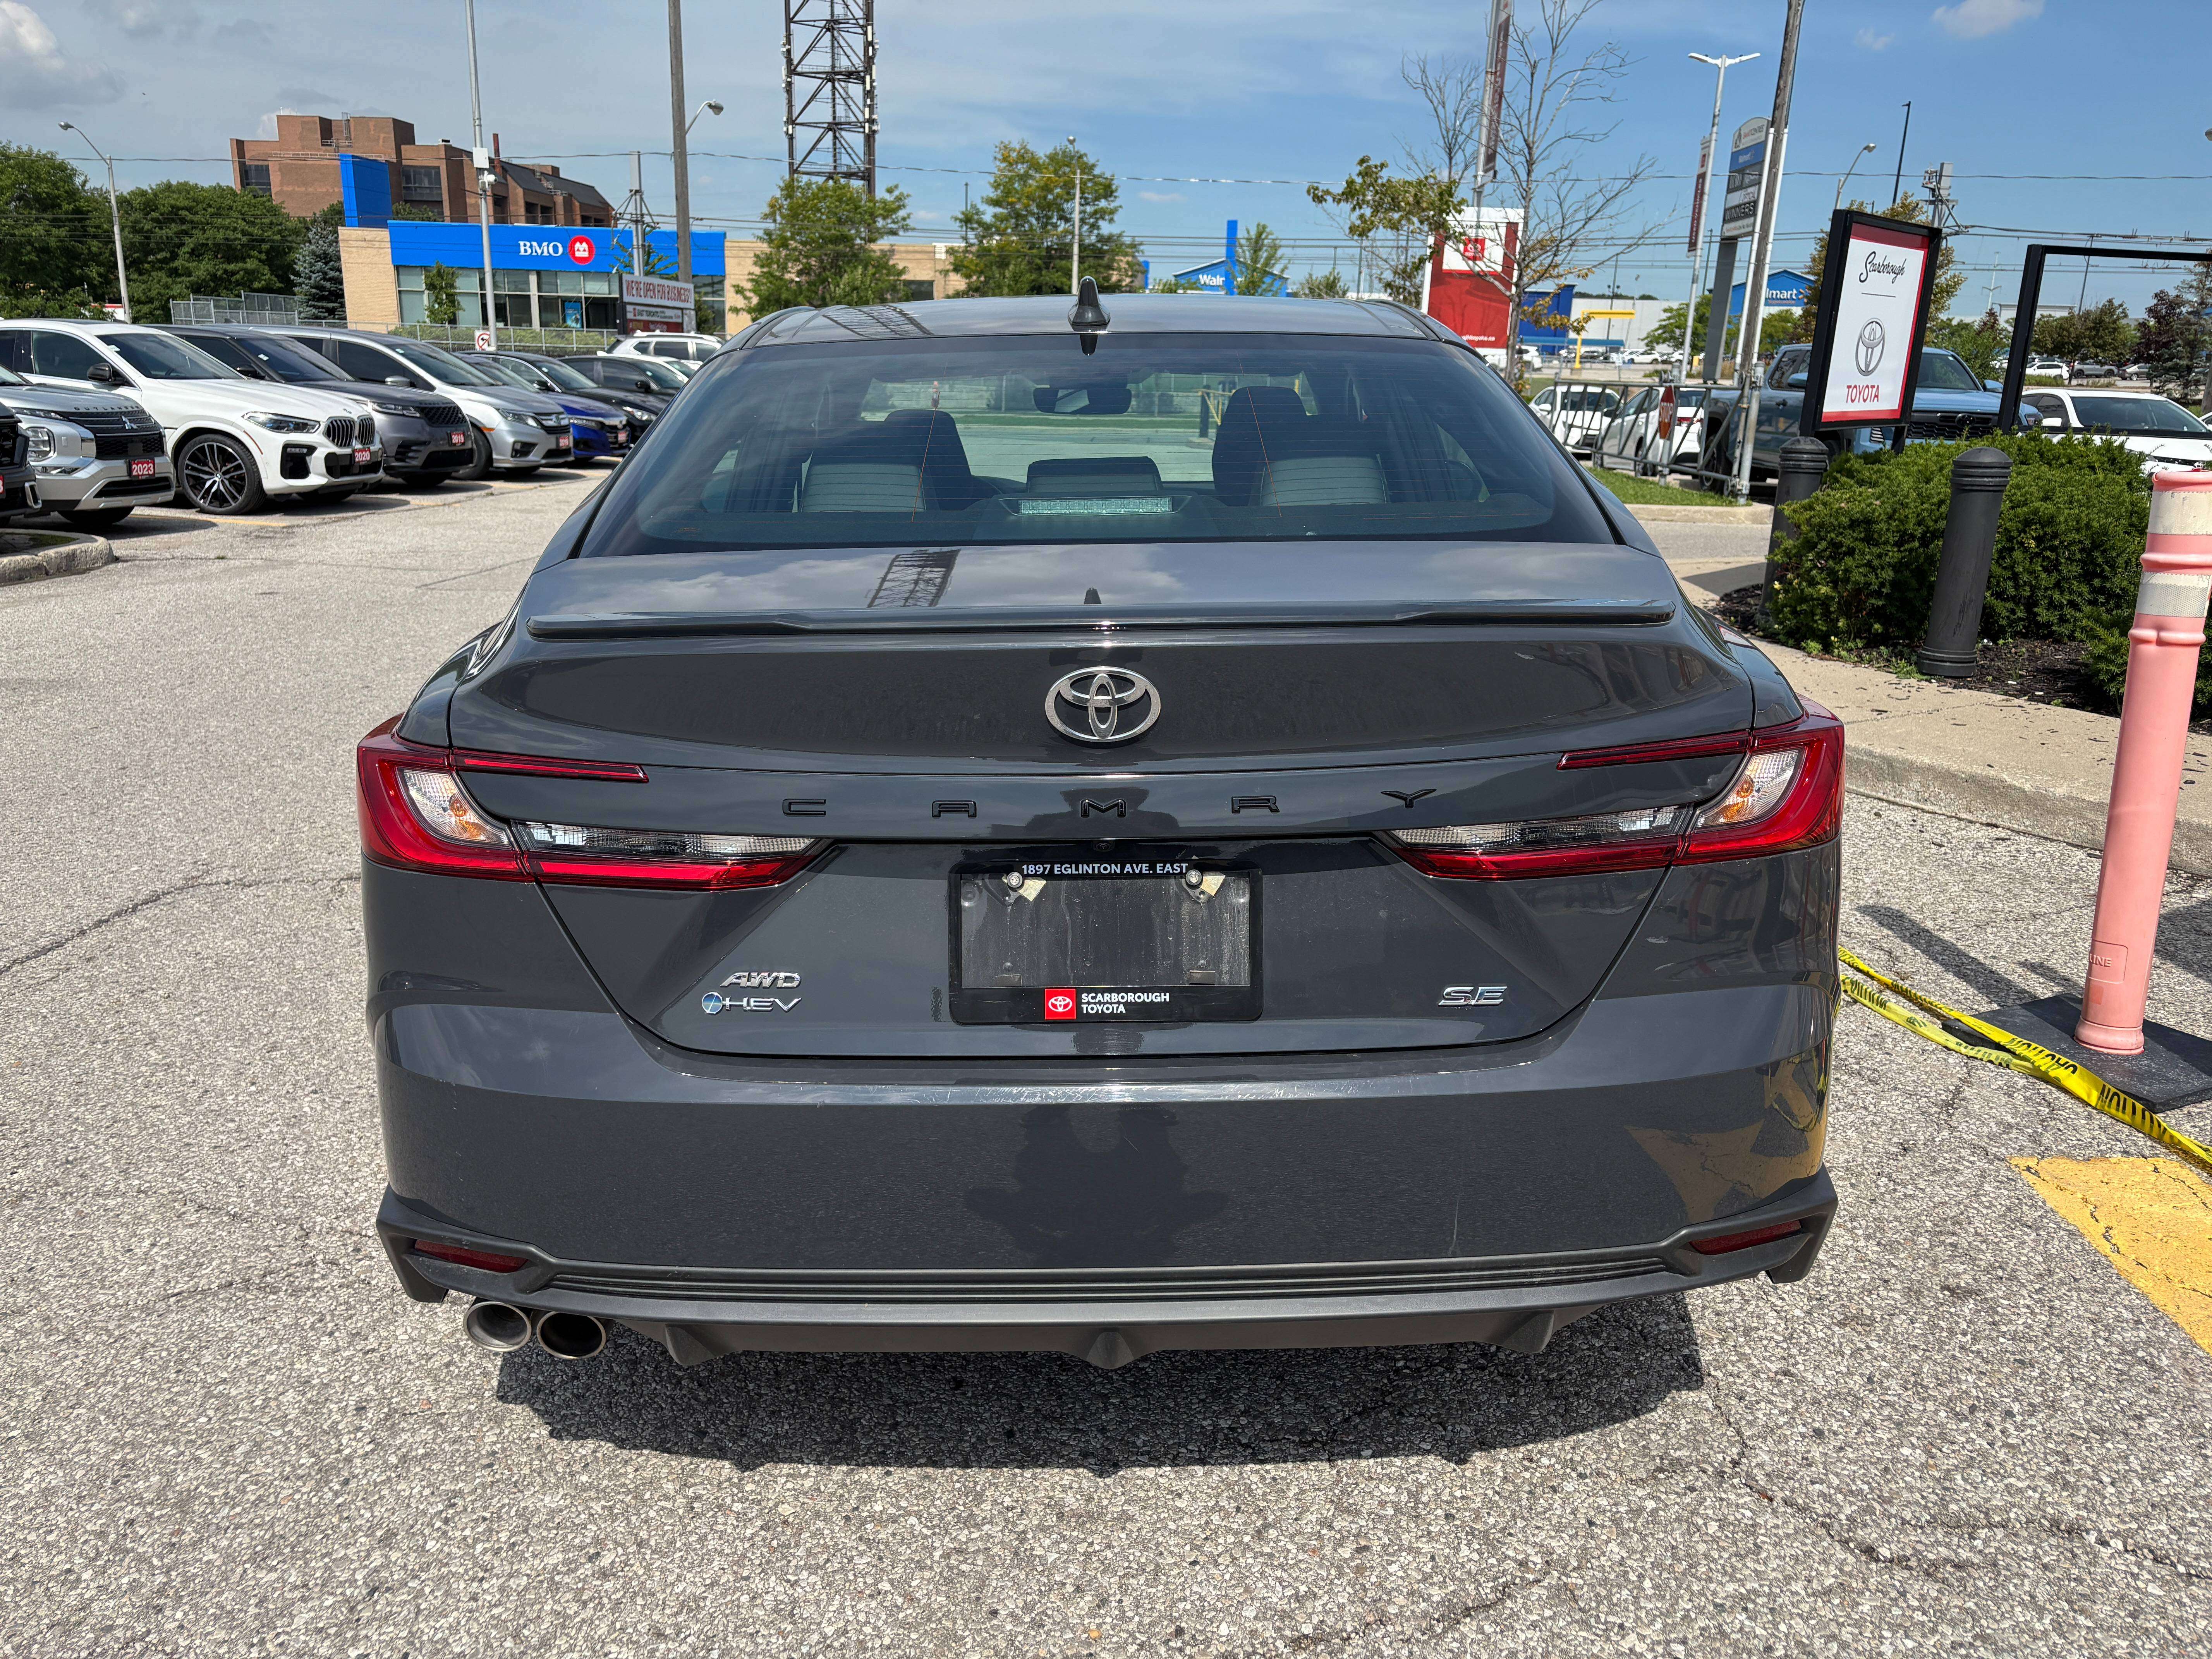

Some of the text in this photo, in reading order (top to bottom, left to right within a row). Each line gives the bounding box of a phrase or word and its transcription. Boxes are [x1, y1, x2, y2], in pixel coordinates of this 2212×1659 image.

[1725, 203, 1755, 220] WINNERS
[518, 241, 563, 256] BMO
[1859, 251, 1907, 284] Scarborough
[625, 279, 642, 298] WE'RE
[643, 282, 657, 300] OPEN
[657, 283, 665, 301] FOR
[1846, 385, 1879, 403] TOYOTA
[1659, 402, 1673, 422] STOP
[355, 450, 370, 461] 2020
[132, 463, 154, 475] 2023
[782, 788, 1437, 818] CAMRY
[1022, 863, 1188, 874] 1897 EGLINTON AVE. EAST
[720, 972, 801, 988] AWD
[1081, 993, 1170, 1003] SCARBOROUGH
[1438, 986, 1507, 1006] SE
[1081, 1004, 1126, 1014] TOYOTA
